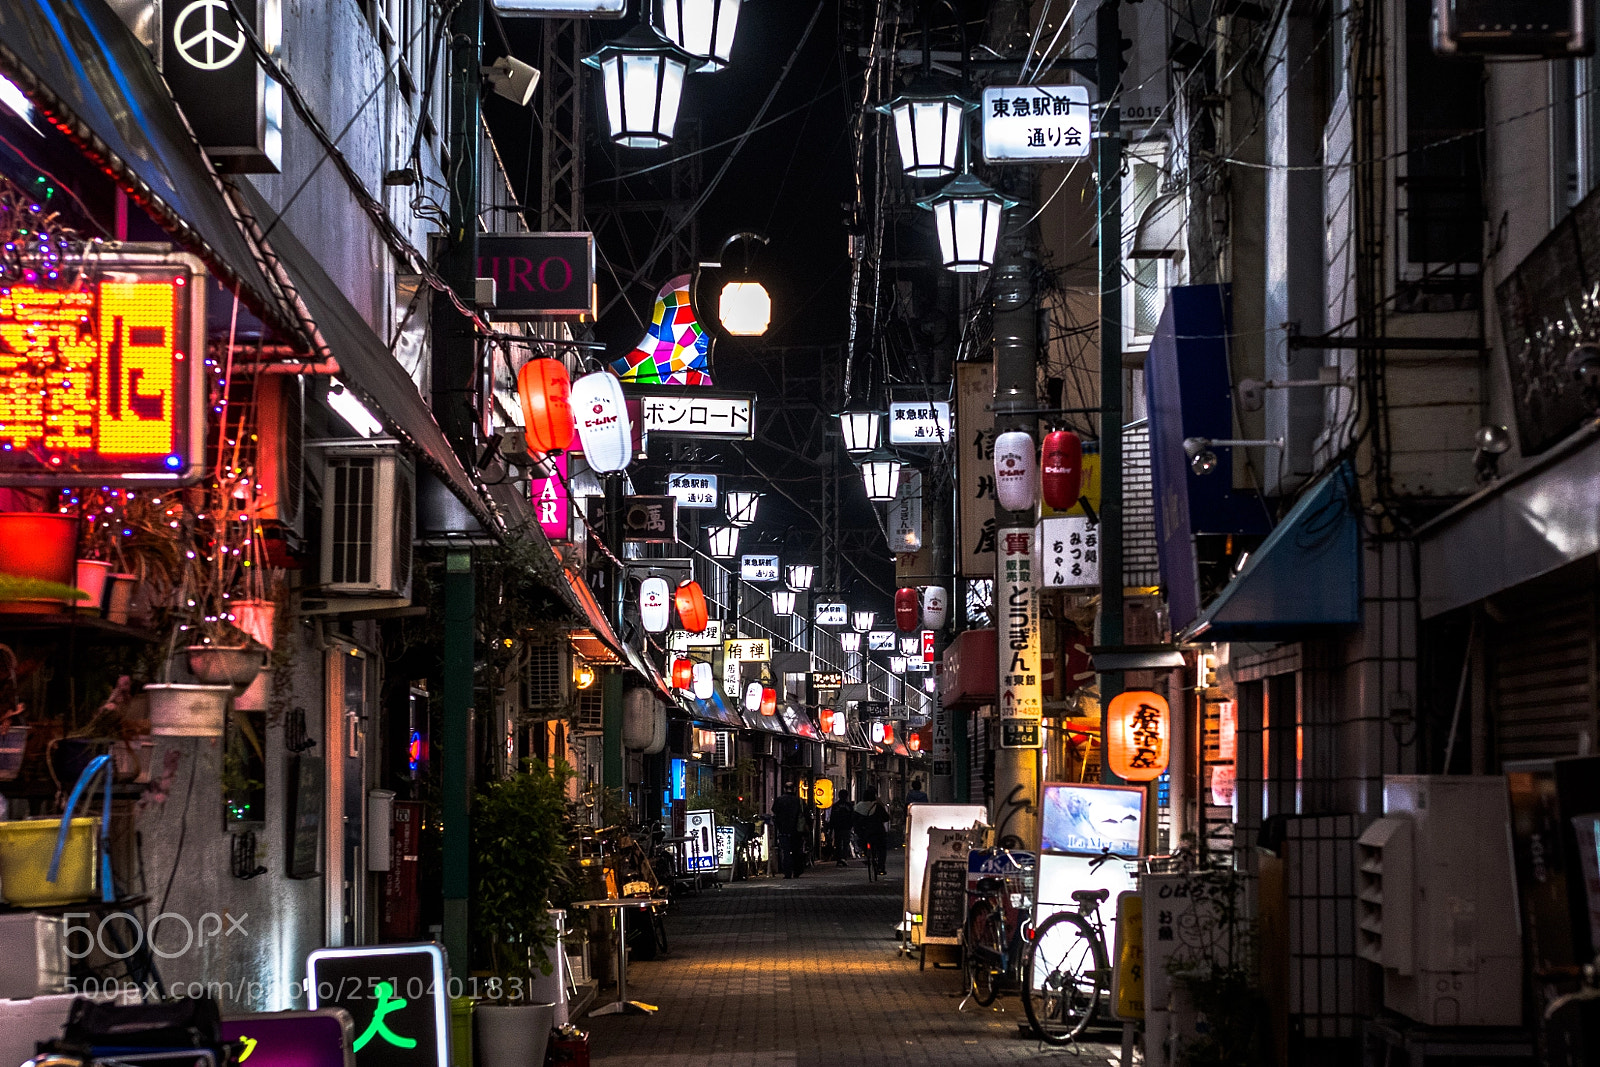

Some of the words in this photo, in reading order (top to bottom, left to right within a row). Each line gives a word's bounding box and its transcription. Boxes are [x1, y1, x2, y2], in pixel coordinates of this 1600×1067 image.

[992, 96, 1070, 117] 東急駅前
[1027, 127, 1082, 147] 通り会
[644, 405, 748, 427] ボンロード
[895, 408, 939, 420] 東急駅前
[915, 426, 944, 437] 通り会
[672, 478, 709, 488] 東急駅前
[688, 493, 713, 503] 通り会
[1006, 533, 1030, 555] 質
[1070, 532, 1082, 577] みつる
[1052, 540, 1064, 585] ちゃん
[1009, 585, 1030, 673] とうぎん
